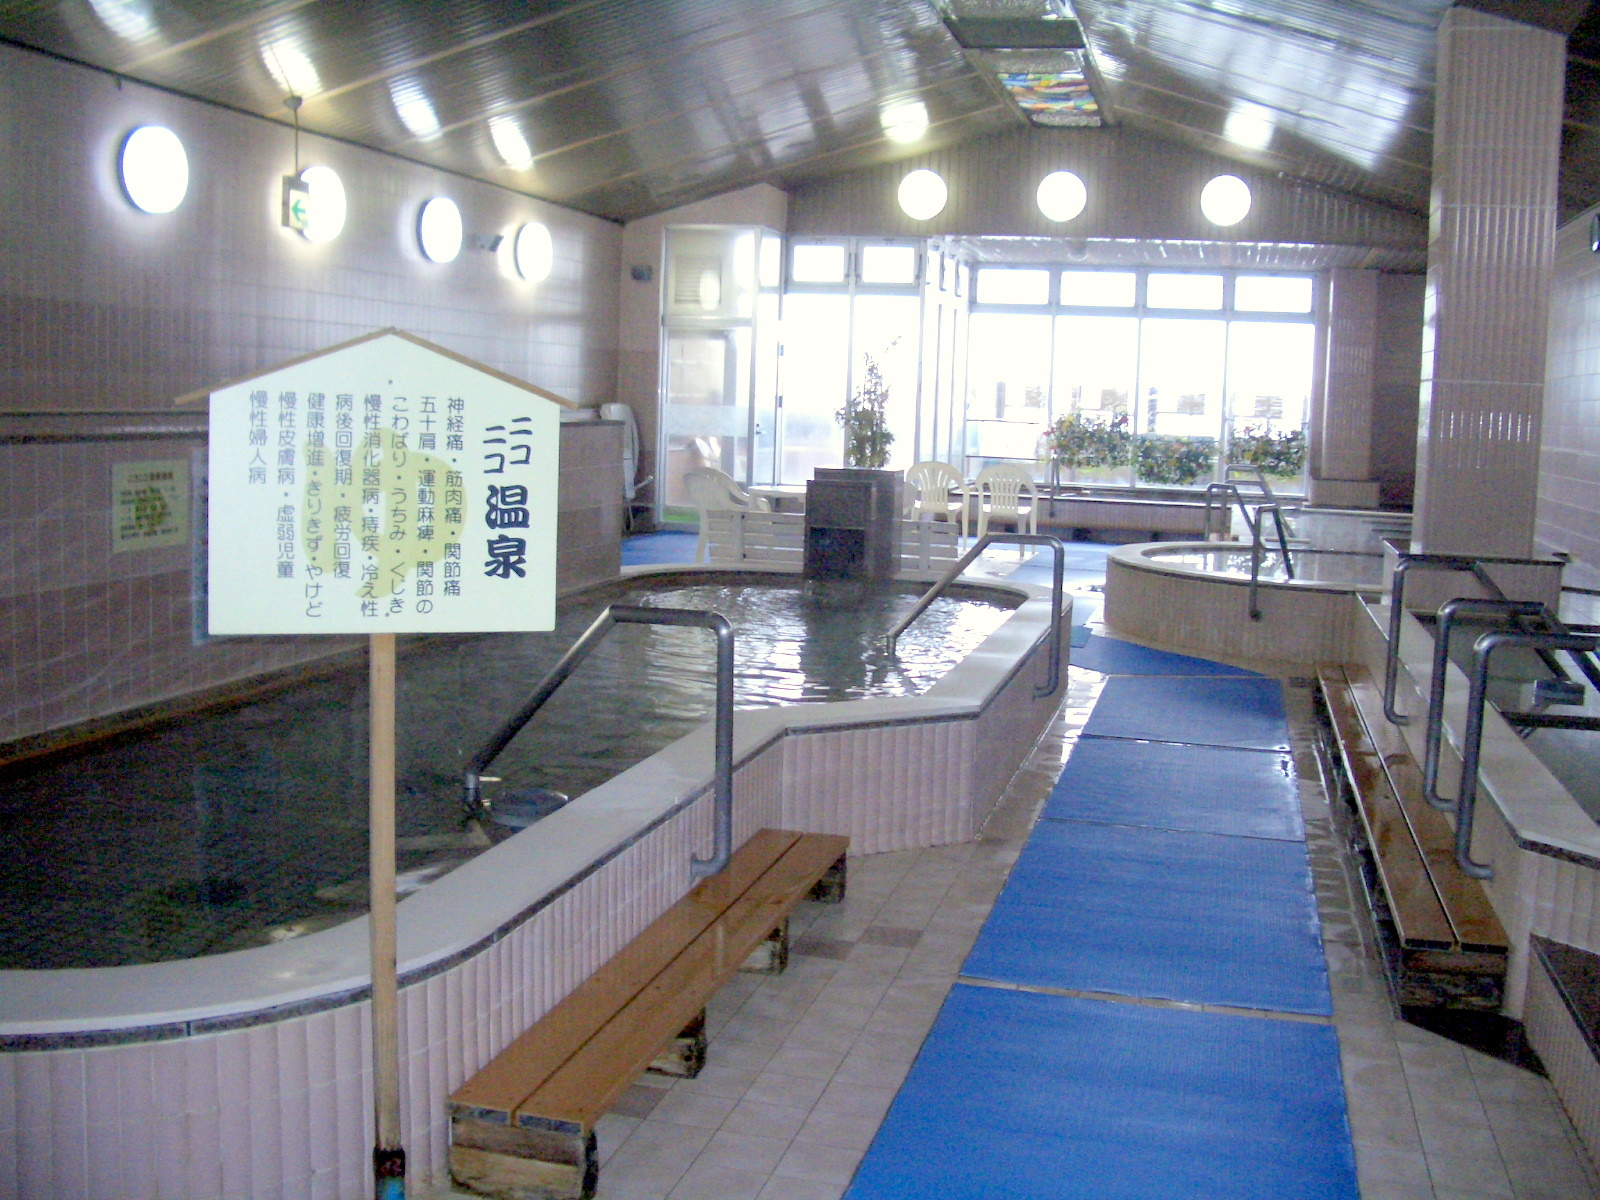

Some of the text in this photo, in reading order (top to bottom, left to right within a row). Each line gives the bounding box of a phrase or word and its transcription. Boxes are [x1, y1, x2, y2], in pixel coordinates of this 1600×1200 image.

[248, 390, 269, 485] 慢性婦人病
